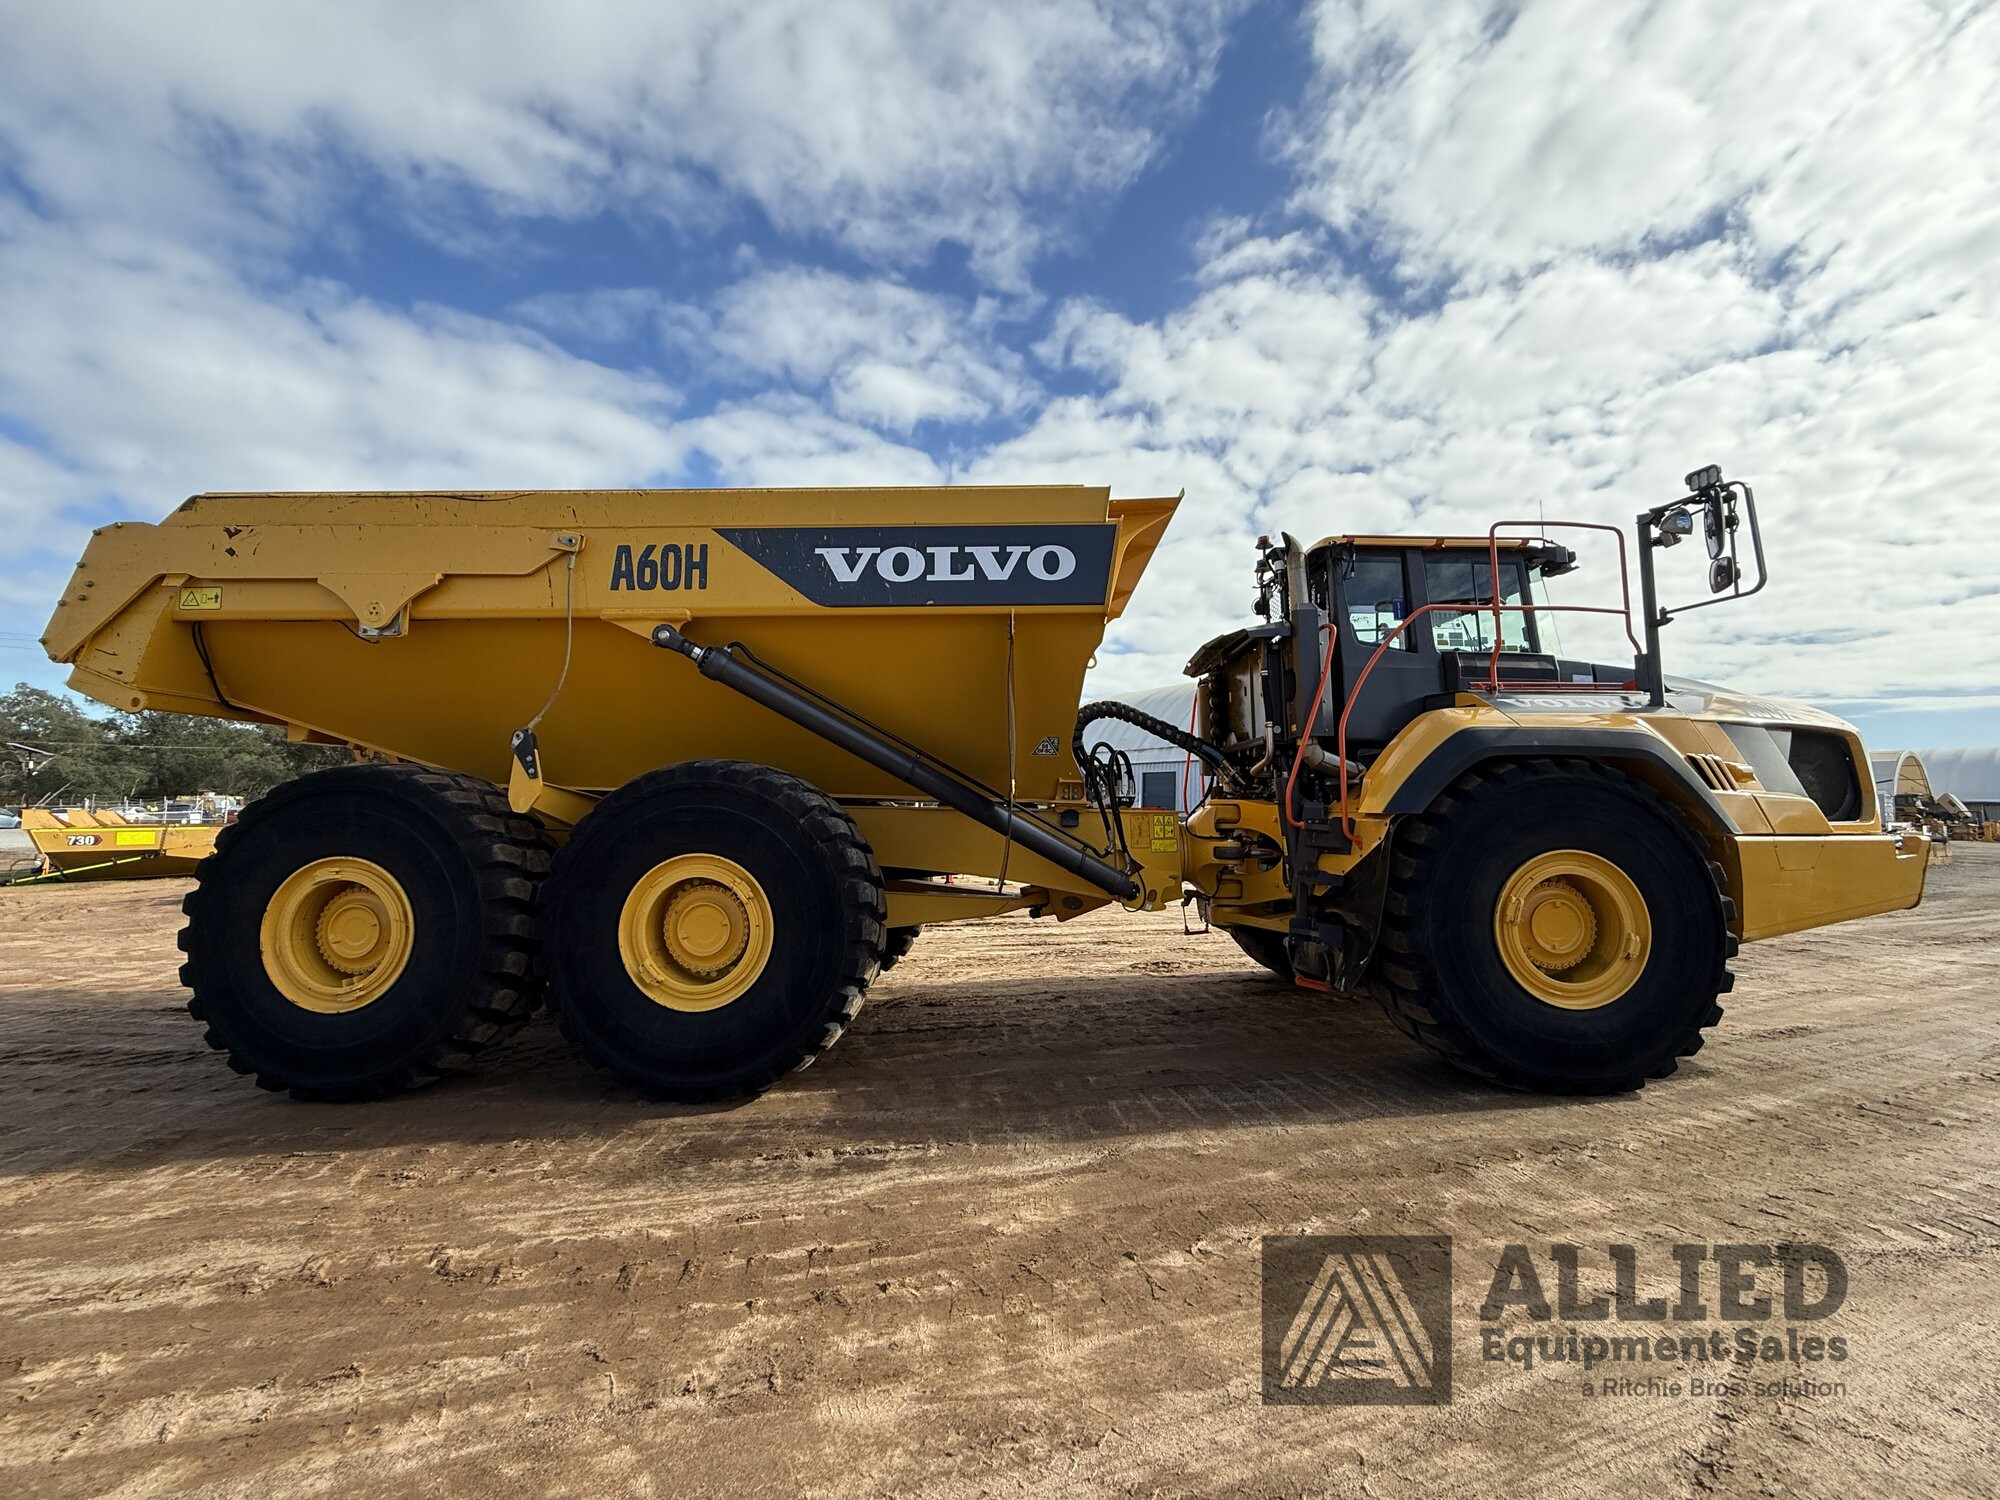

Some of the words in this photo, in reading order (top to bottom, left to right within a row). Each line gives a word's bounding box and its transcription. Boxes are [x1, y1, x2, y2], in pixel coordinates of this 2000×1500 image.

[610, 543, 708, 591] A60H
[815, 544, 1076, 582] VOLVO
[67, 835, 95, 846] 730
